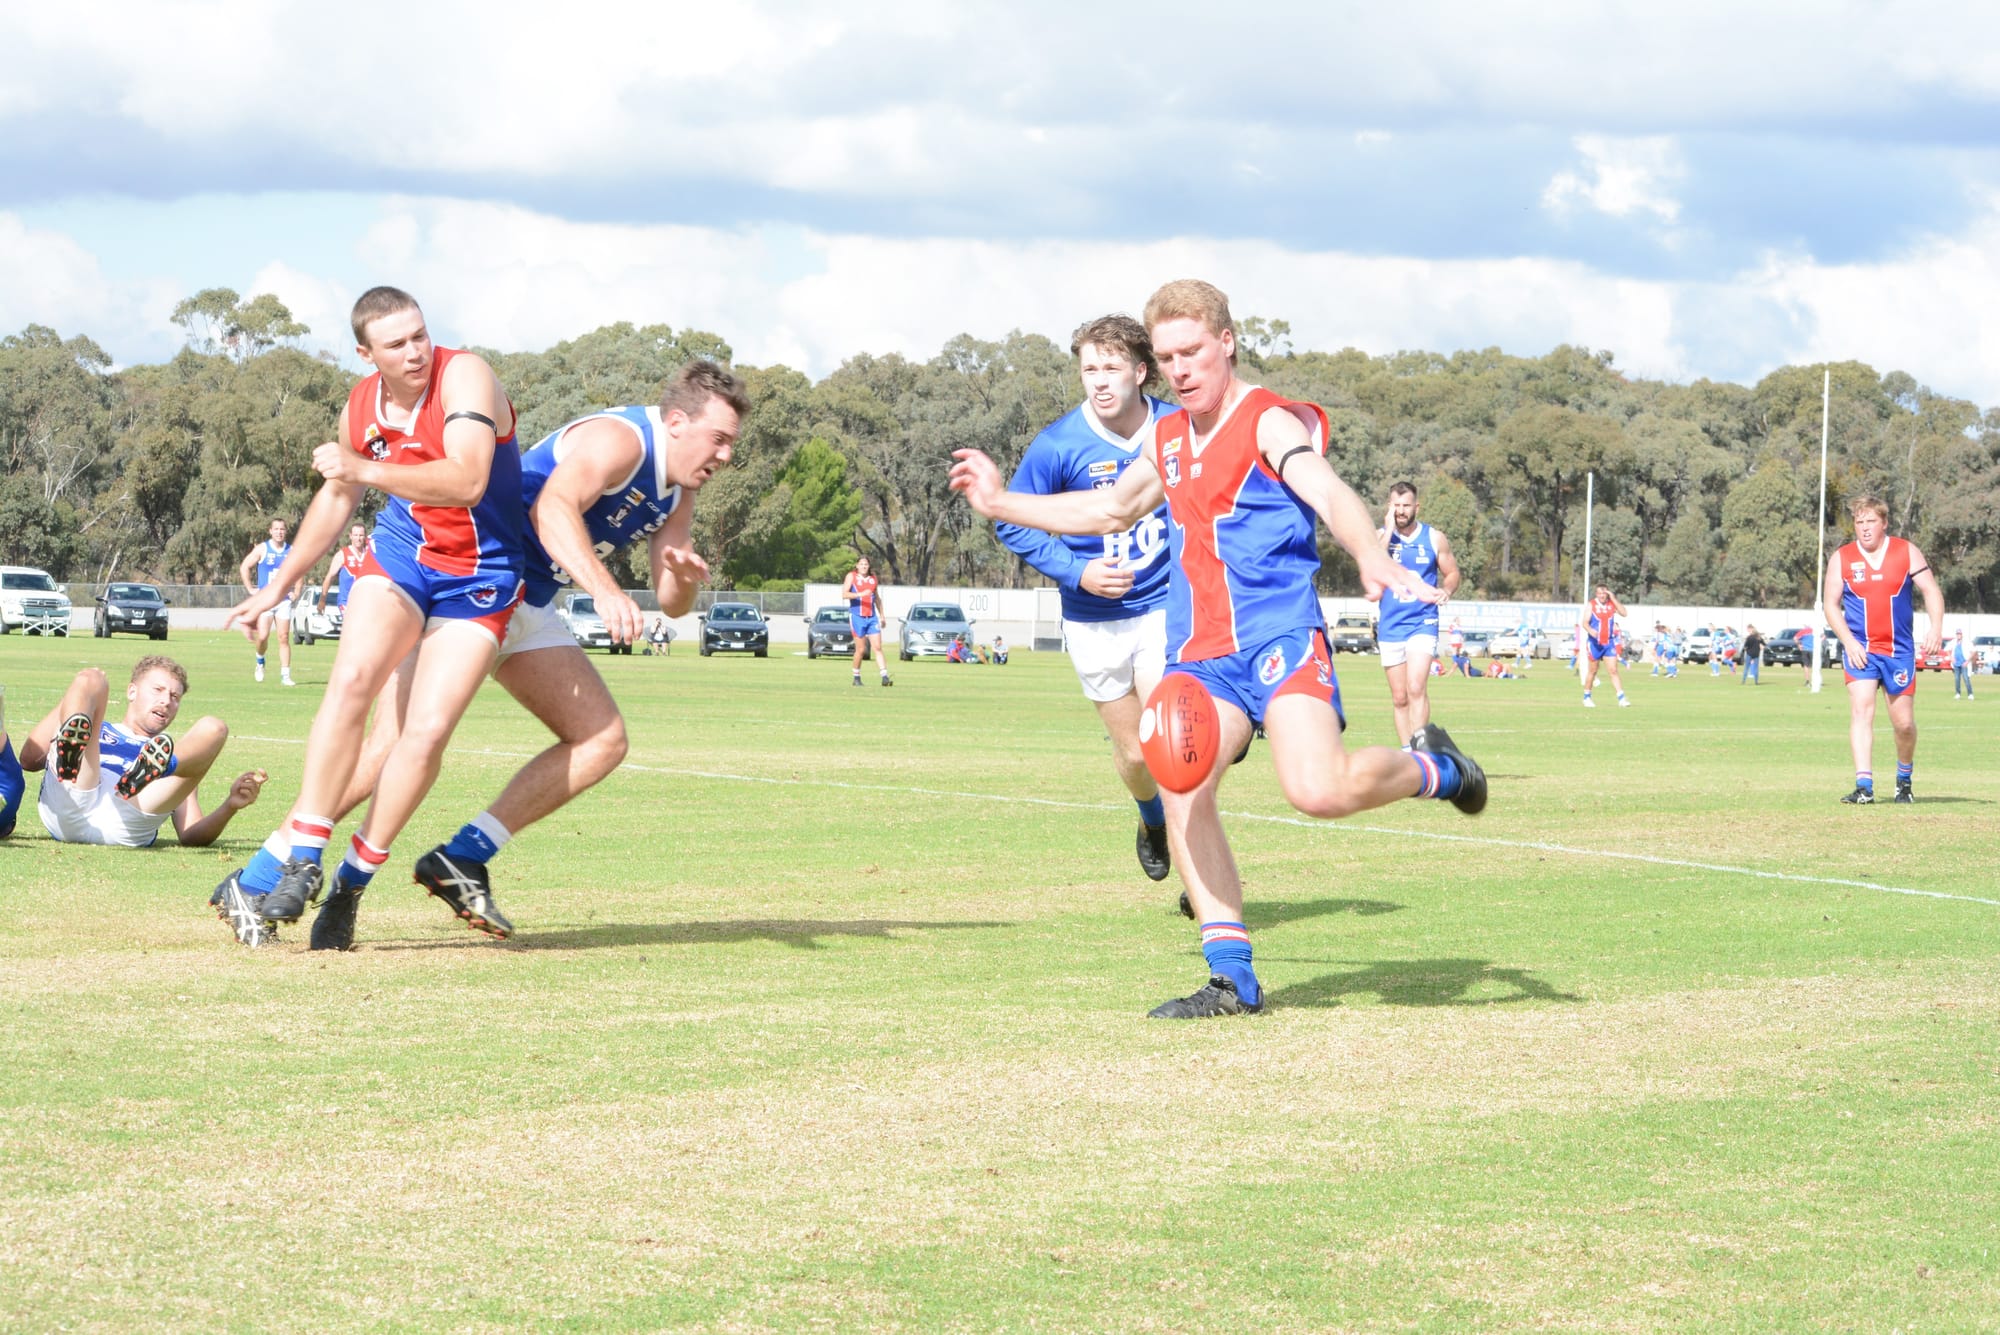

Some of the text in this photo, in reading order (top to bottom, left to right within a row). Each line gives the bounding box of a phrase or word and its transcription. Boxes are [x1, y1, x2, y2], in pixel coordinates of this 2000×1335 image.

[969, 594, 989, 611] 200
[1527, 609, 1546, 628] ST
[1546, 609, 1578, 628] ARN
